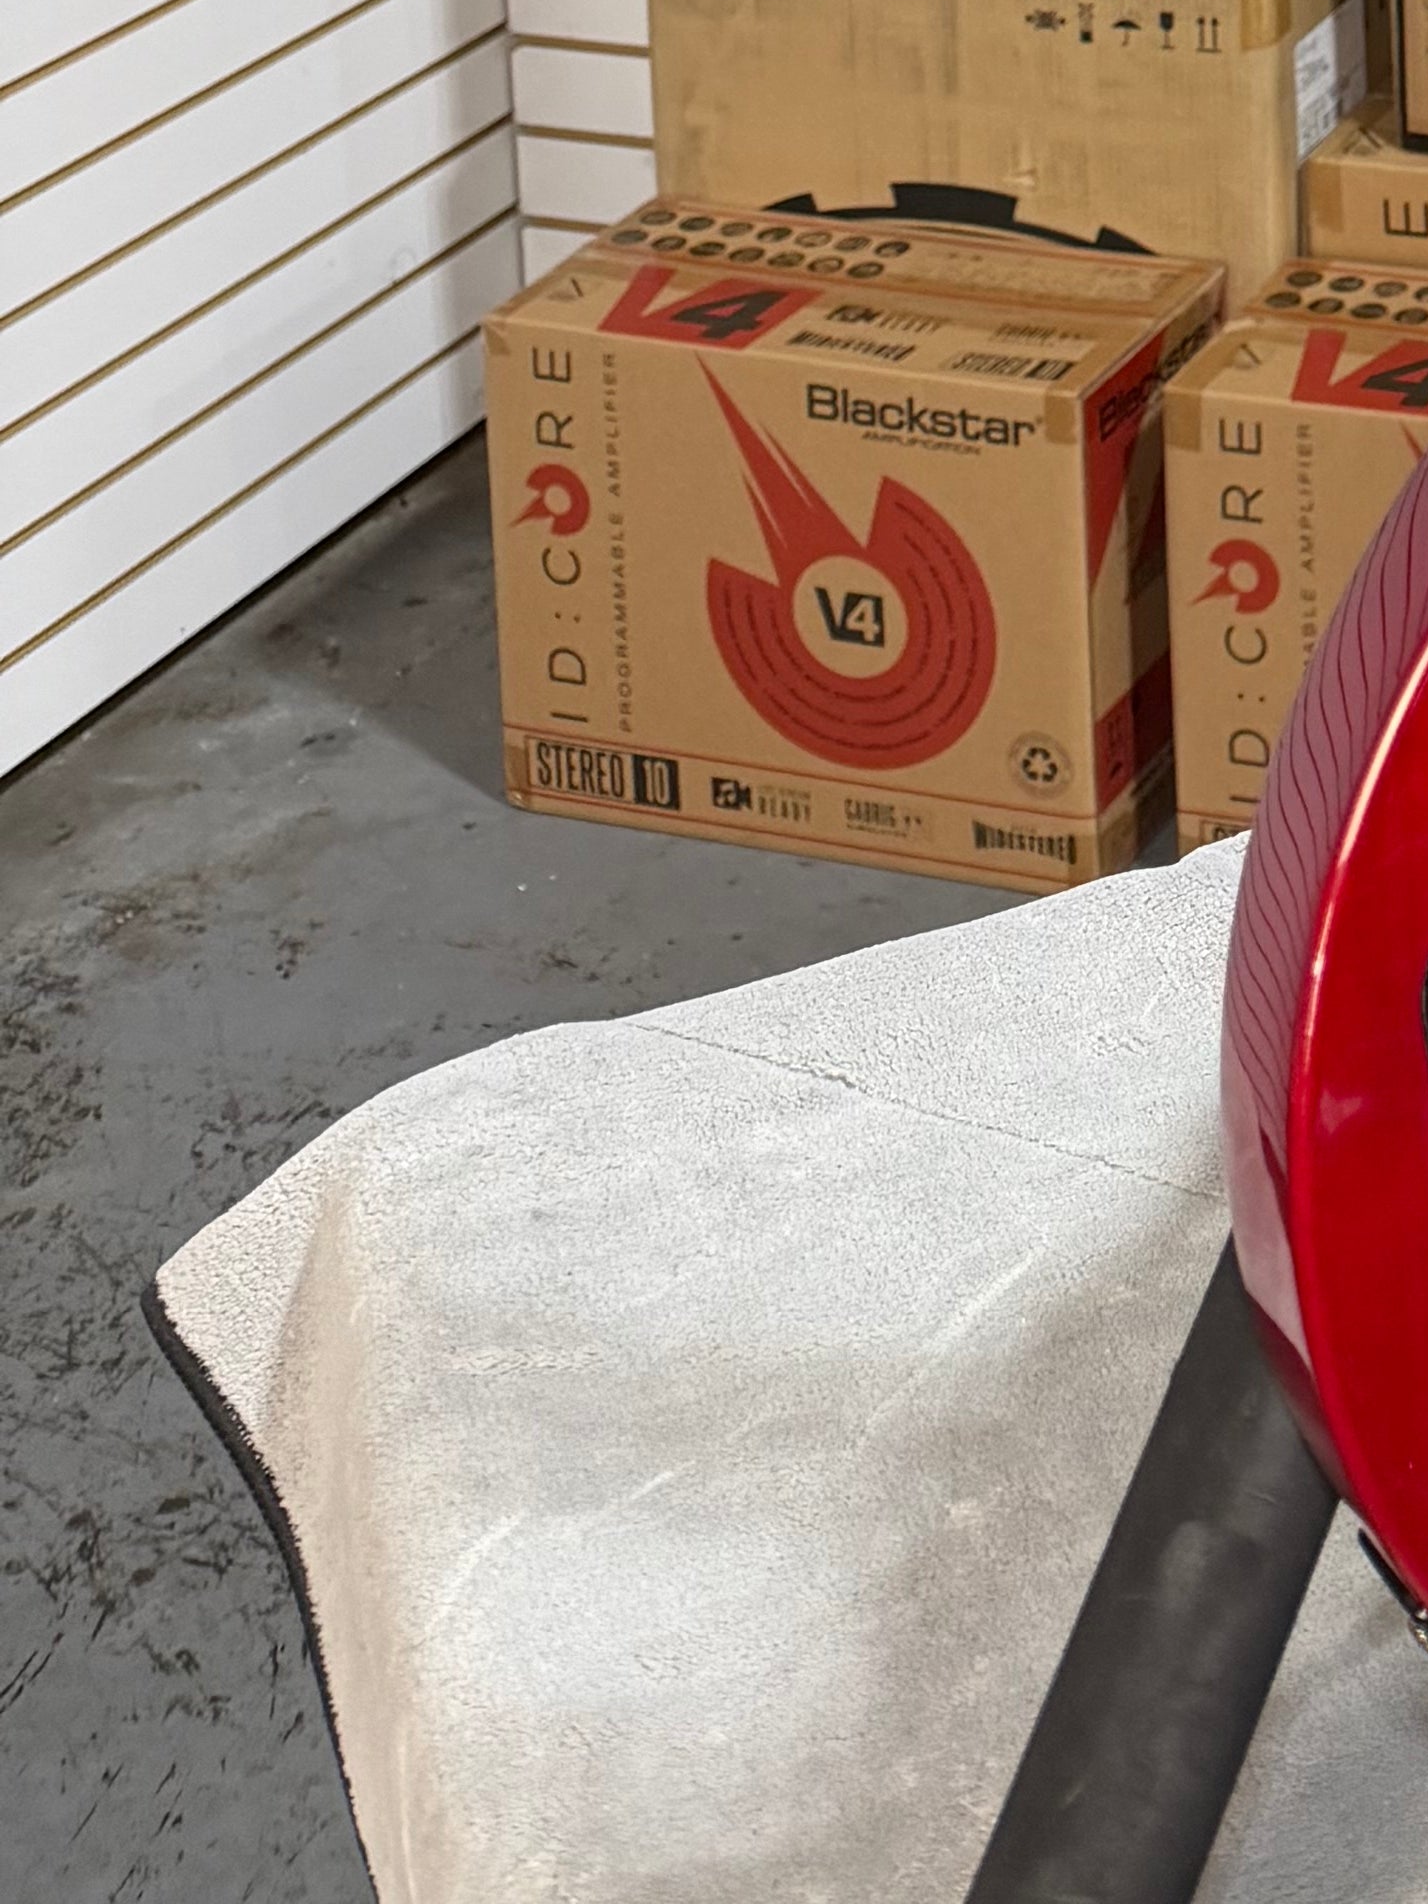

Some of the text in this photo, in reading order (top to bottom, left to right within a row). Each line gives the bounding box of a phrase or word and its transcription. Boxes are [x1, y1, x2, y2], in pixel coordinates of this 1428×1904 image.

[597, 264, 825, 351] V4
[806, 382, 1036, 447] Blackstar
[1296, 423, 1316, 574] AMPLIFIER
[602, 352, 633, 734] PROGRAMMABLE AMPLIFIER
[814, 586, 885, 649] V4
[536, 742, 673, 808] STEREO 10
